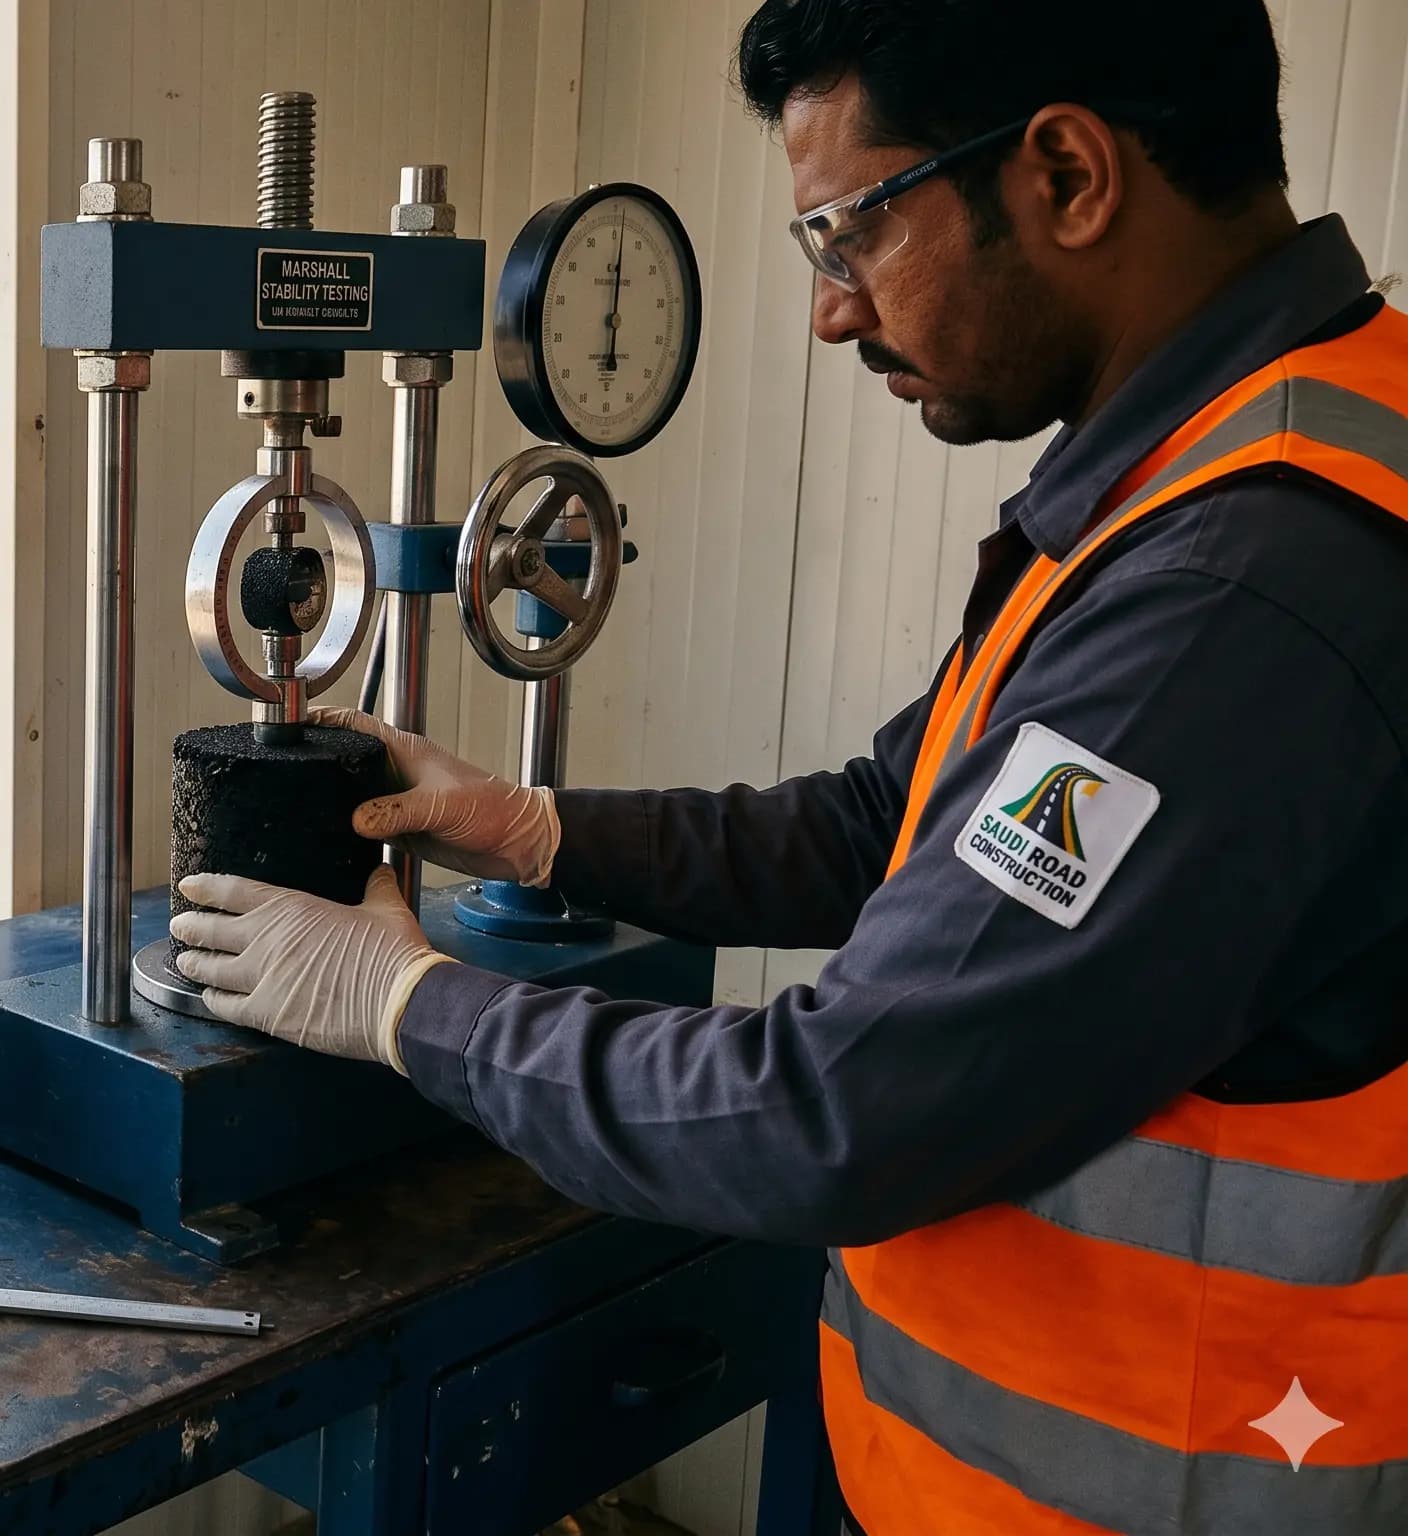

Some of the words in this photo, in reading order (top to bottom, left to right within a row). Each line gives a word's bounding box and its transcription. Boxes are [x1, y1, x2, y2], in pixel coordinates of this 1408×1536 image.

[261, 282, 321, 301] STABILITY
[322, 284, 369, 302] TESTING
[282, 259, 351, 280] MARSHALL
[969, 833, 1077, 908] CONSTRUCTION
[979, 814, 1031, 857] SAUDI
[1026, 846, 1088, 889] ROAD
